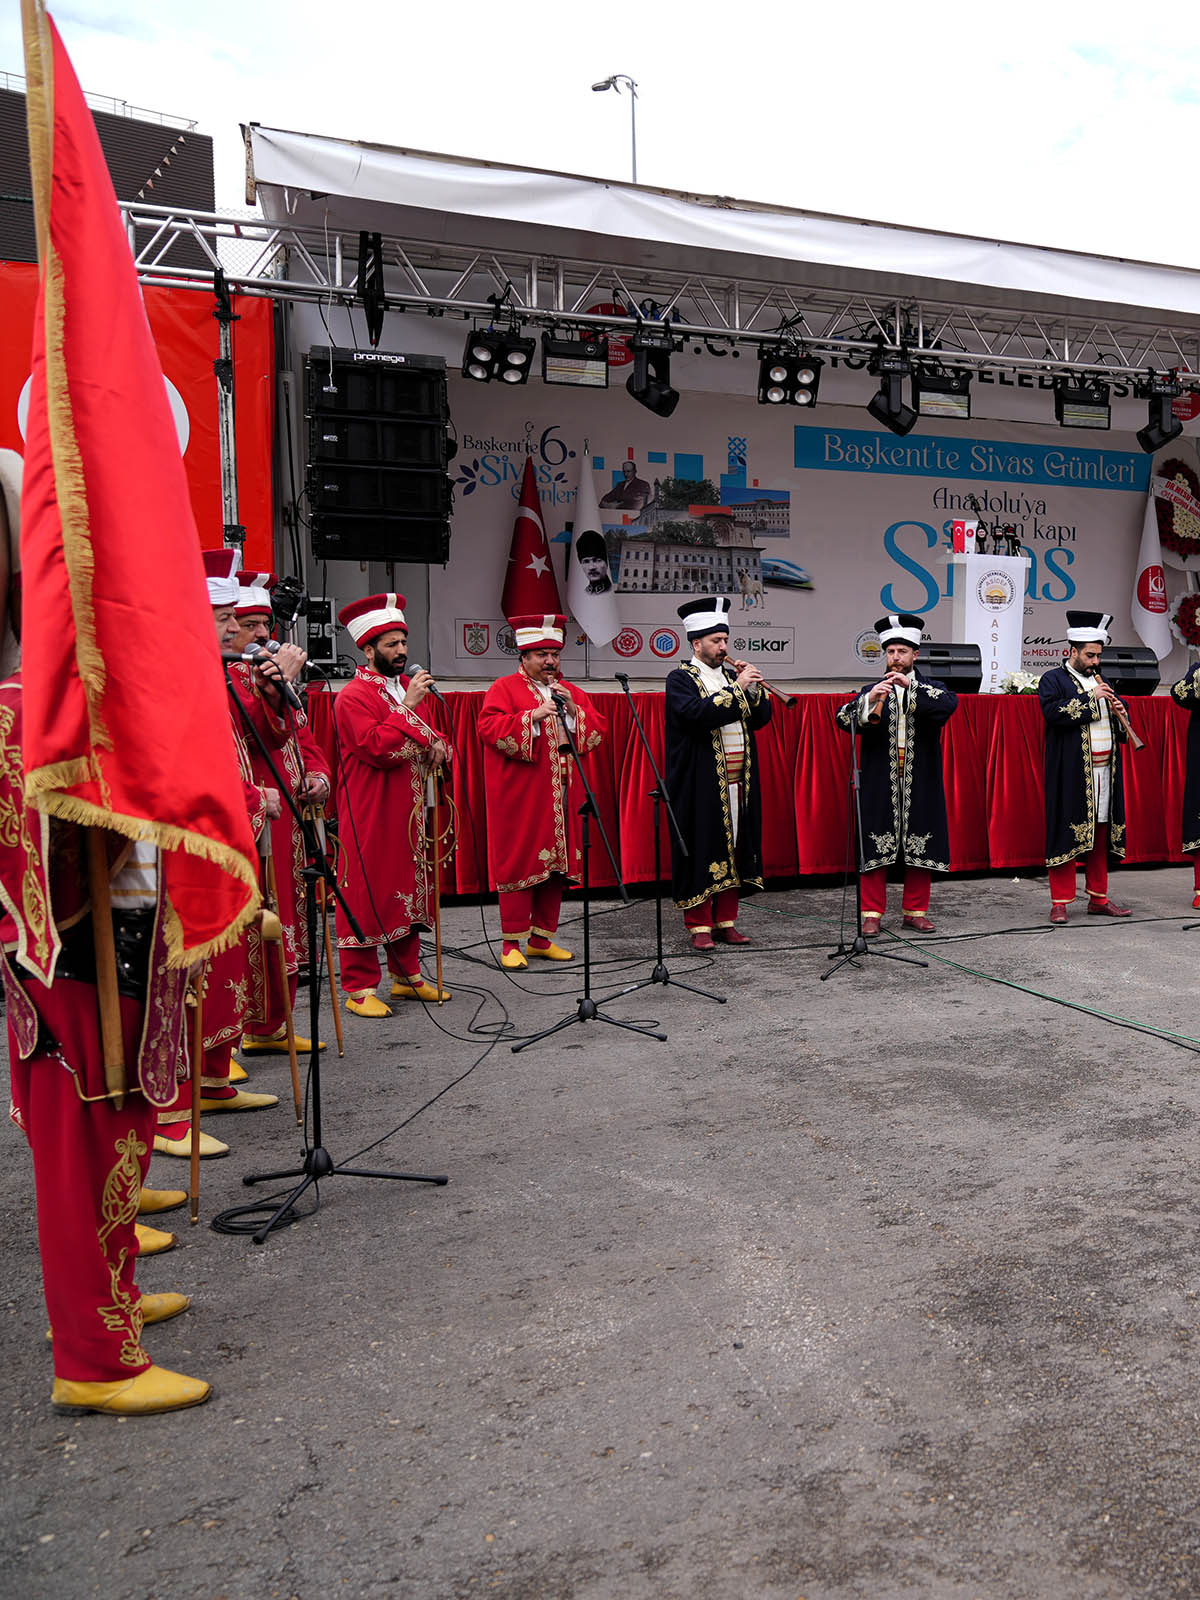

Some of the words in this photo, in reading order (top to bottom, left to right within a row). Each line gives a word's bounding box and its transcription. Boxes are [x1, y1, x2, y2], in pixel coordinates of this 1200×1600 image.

[353, 352, 406, 364] promega
[480, 454, 553, 486] Sivs
[824, 433, 961, 469] Başkent'te
[970, 444, 1034, 476] Sivas
[1043, 451, 1136, 484] Günleri
[511, 482, 578, 507] Gnleri
[1033, 516, 1077, 547] kapı
